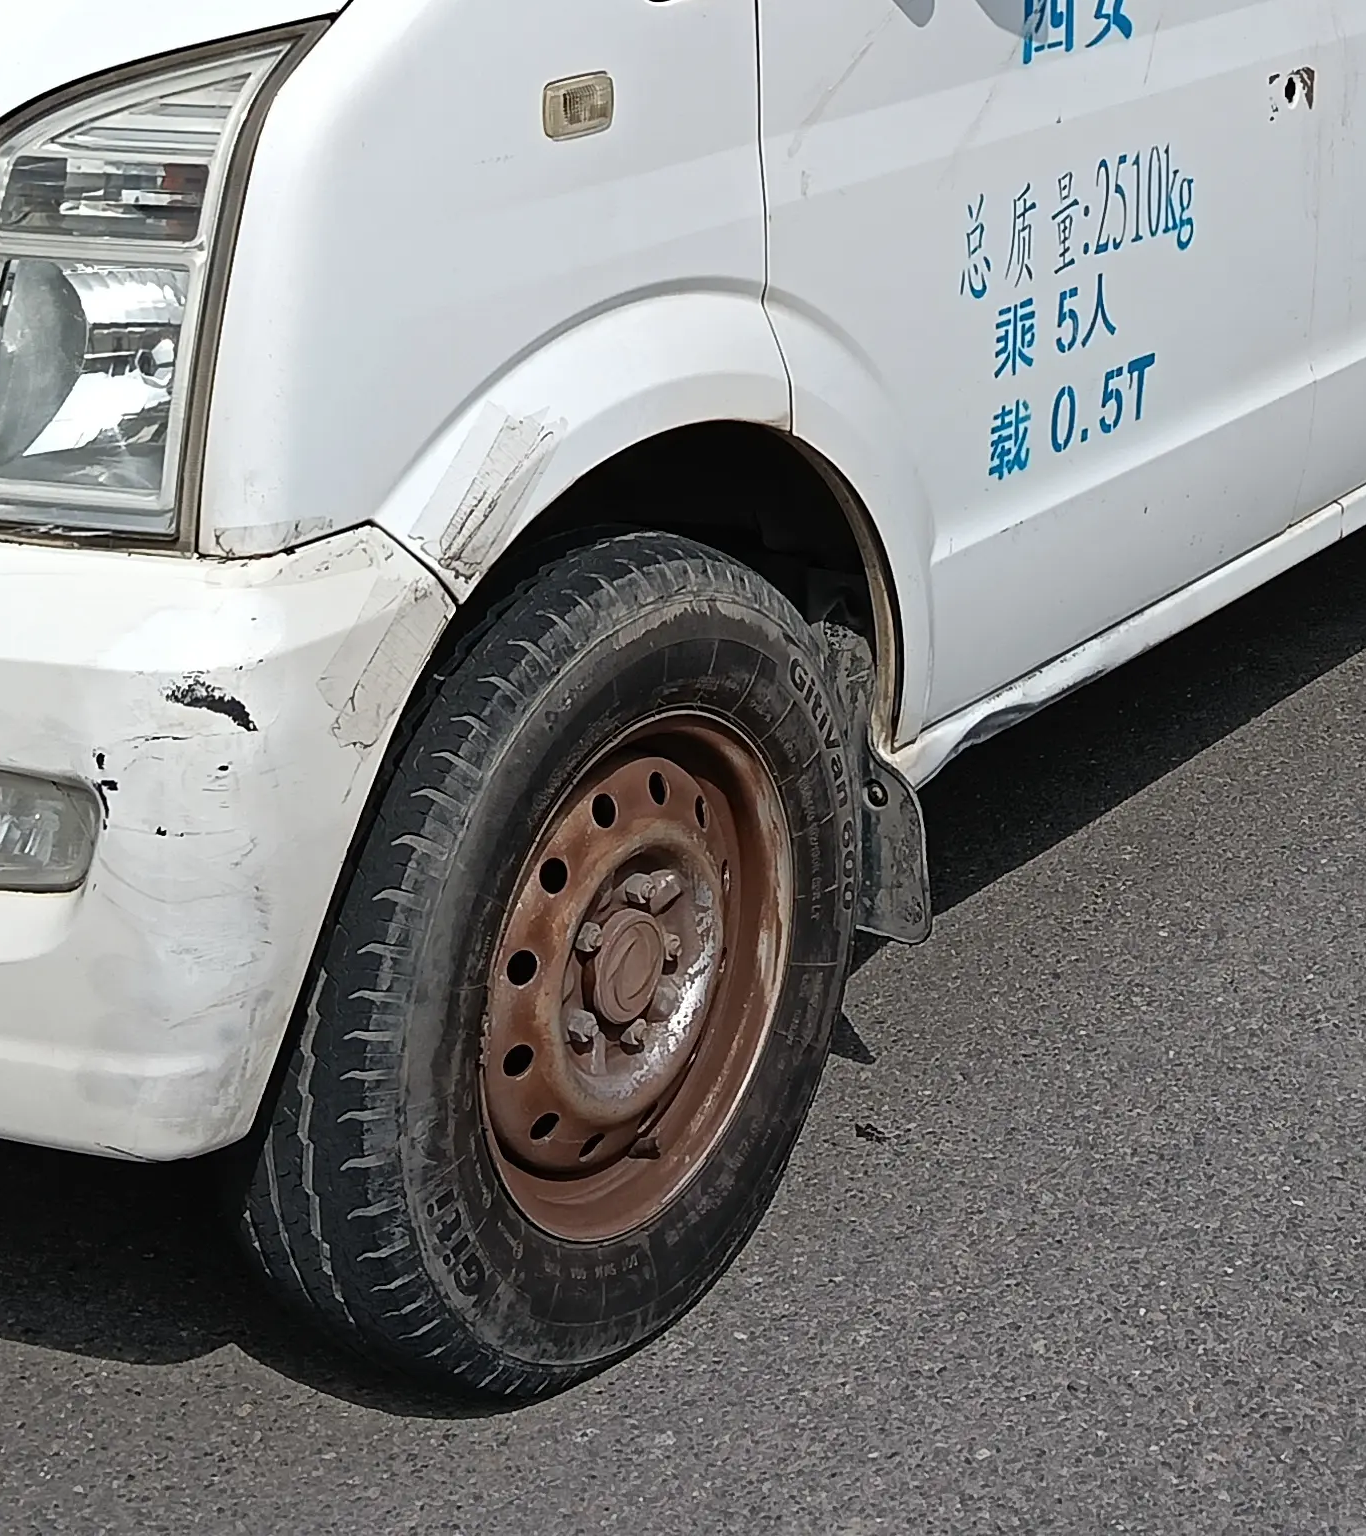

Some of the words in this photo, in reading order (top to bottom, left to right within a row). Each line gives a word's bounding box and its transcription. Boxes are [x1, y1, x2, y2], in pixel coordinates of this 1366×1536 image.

[988, 398, 1033, 481] 载
[1051, 353, 1156, 453] 0.5T
[788, 657, 849, 809] GitiVan
[842, 819, 854, 911] 600
[426, 1188, 485, 1297] Giti
